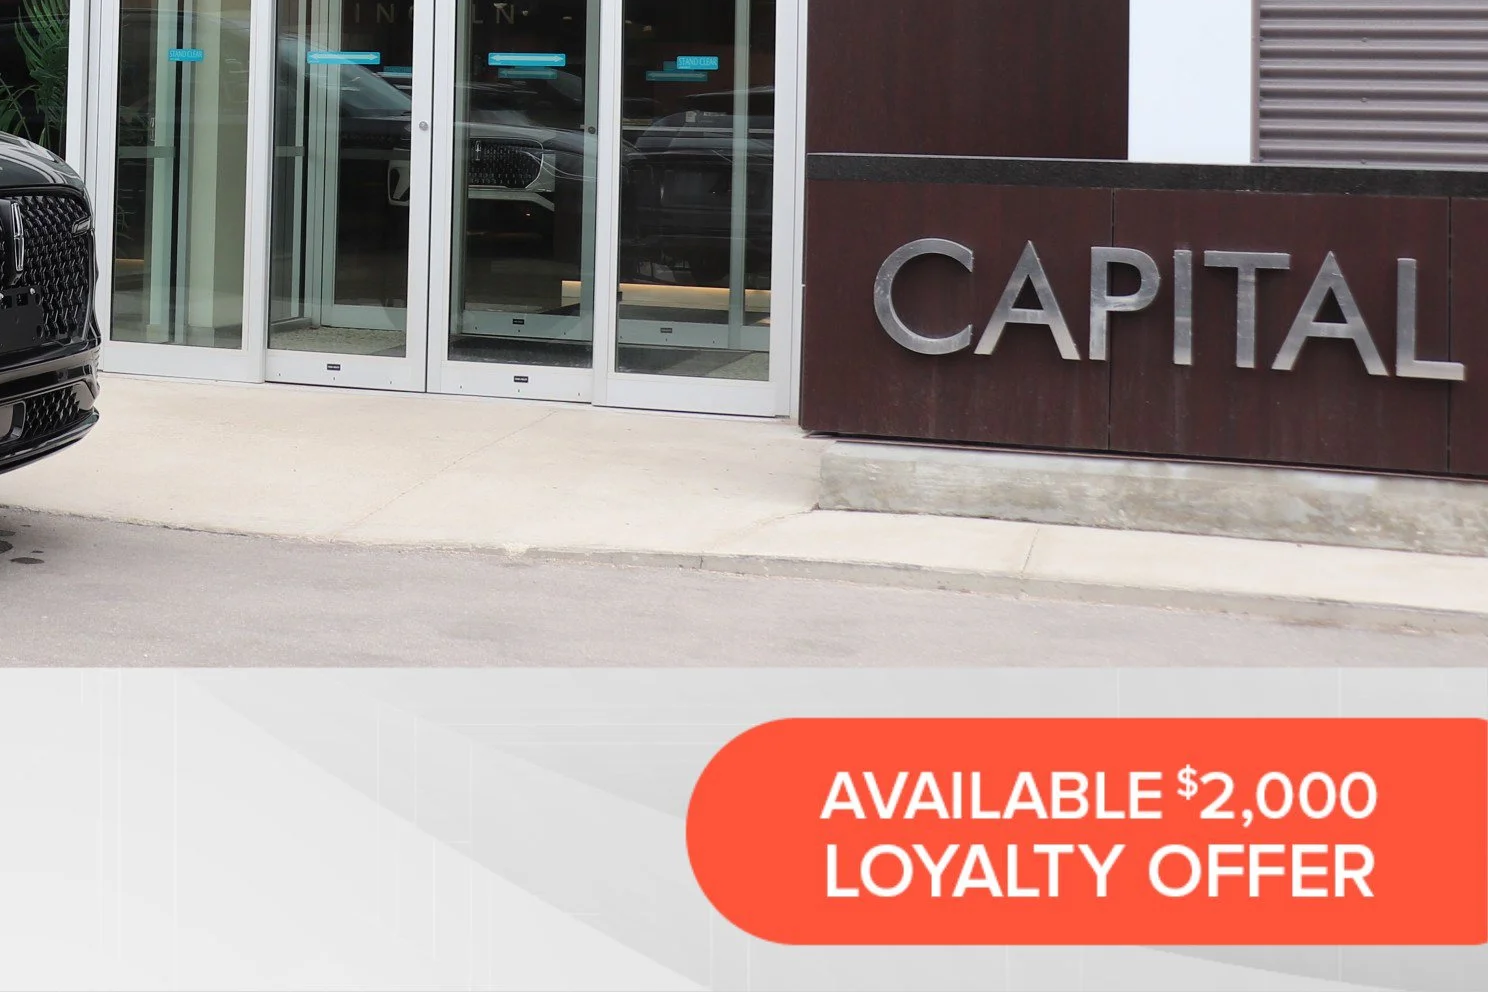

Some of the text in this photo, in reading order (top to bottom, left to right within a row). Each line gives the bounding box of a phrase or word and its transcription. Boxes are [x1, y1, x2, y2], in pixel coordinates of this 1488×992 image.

[679, 57, 717, 66] STAND CLEAR
[873, 237, 1466, 381] CAPITAL
